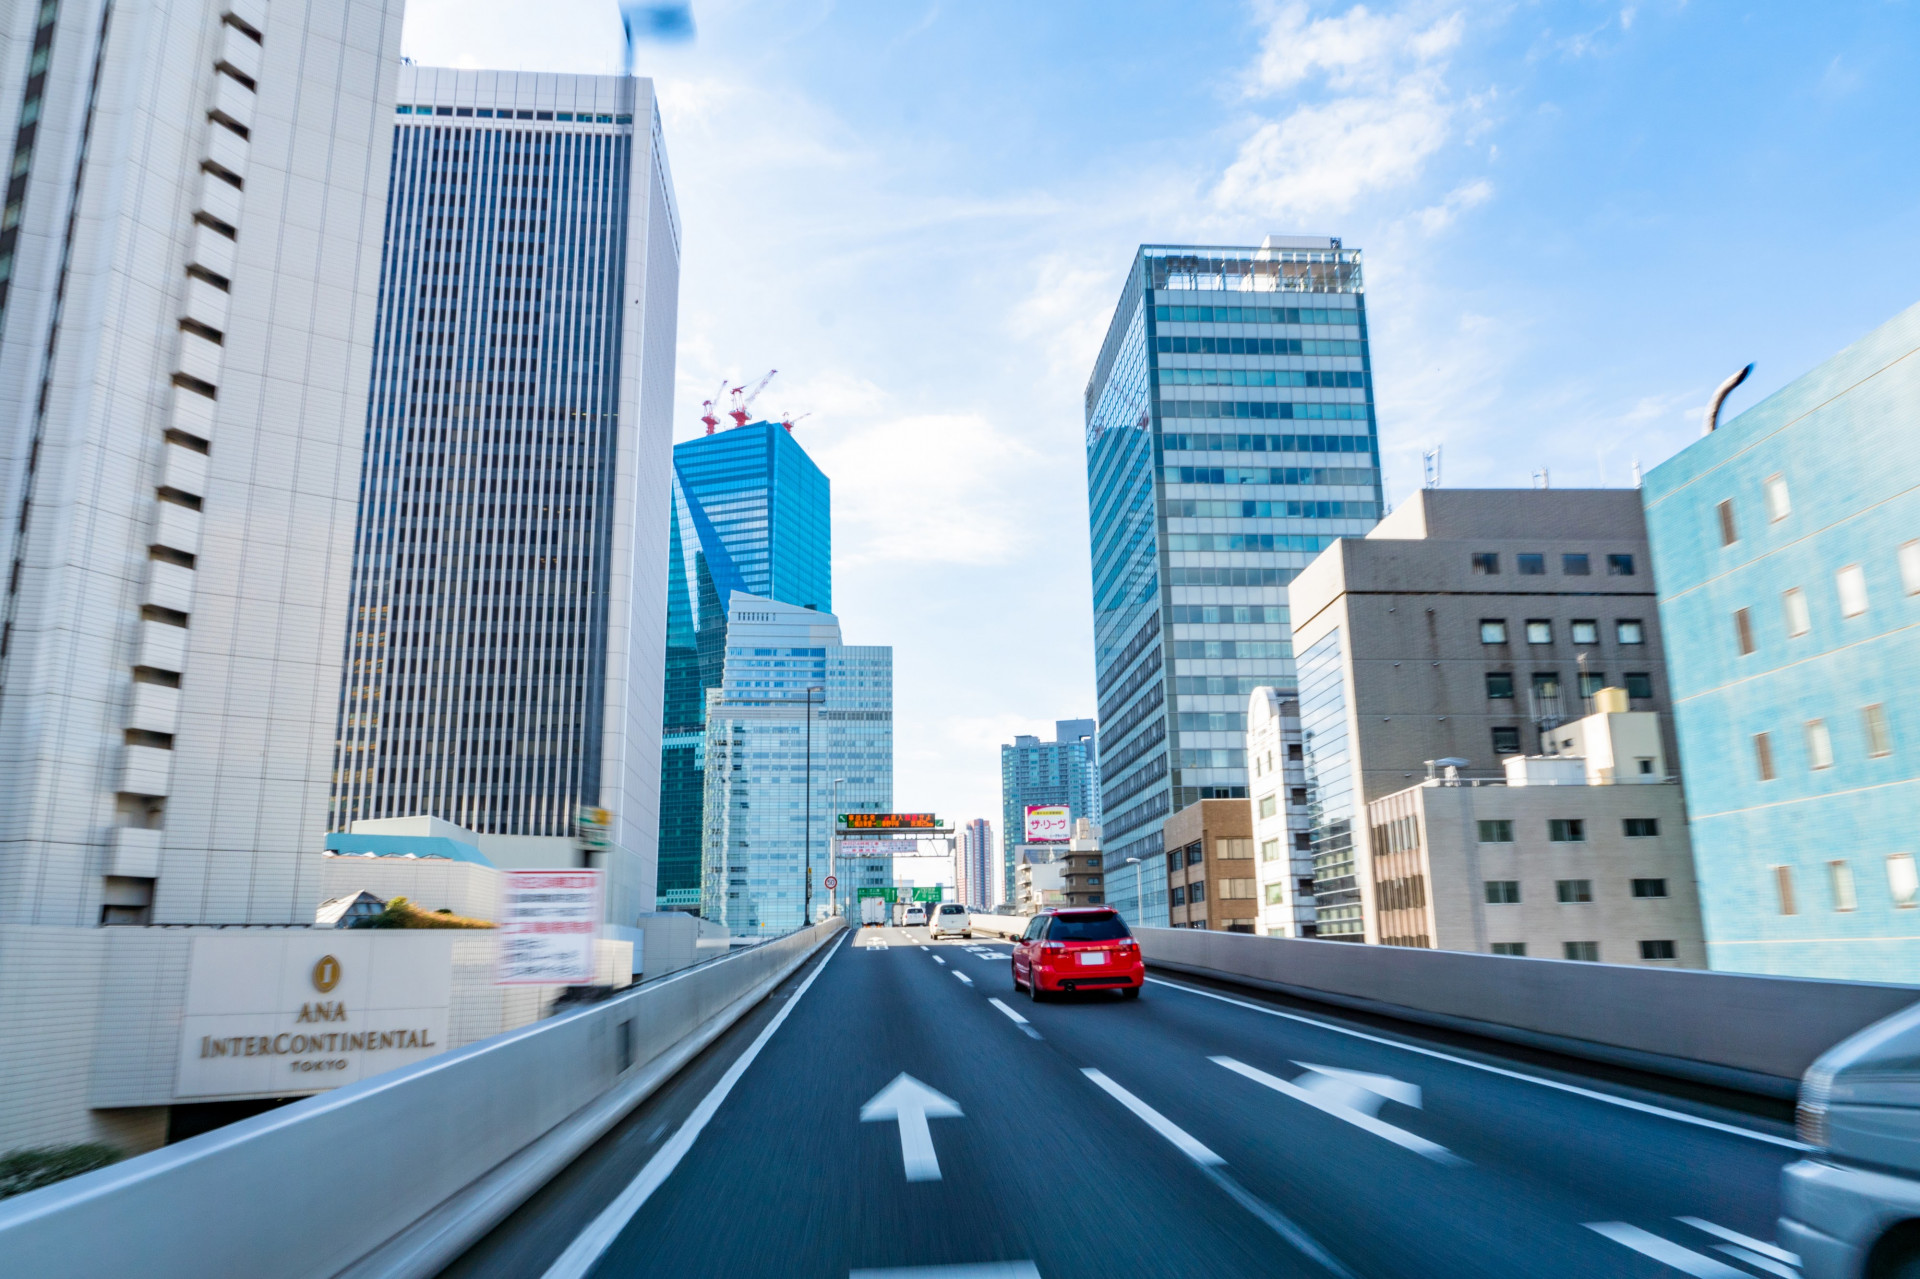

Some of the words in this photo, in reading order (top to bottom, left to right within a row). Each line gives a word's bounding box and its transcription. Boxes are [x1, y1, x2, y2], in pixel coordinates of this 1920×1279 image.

[1030, 819, 1067, 830] ザ・リーヴ
[296, 1001, 347, 1023] ANA
[291, 1059, 348, 1072] TOKYO
